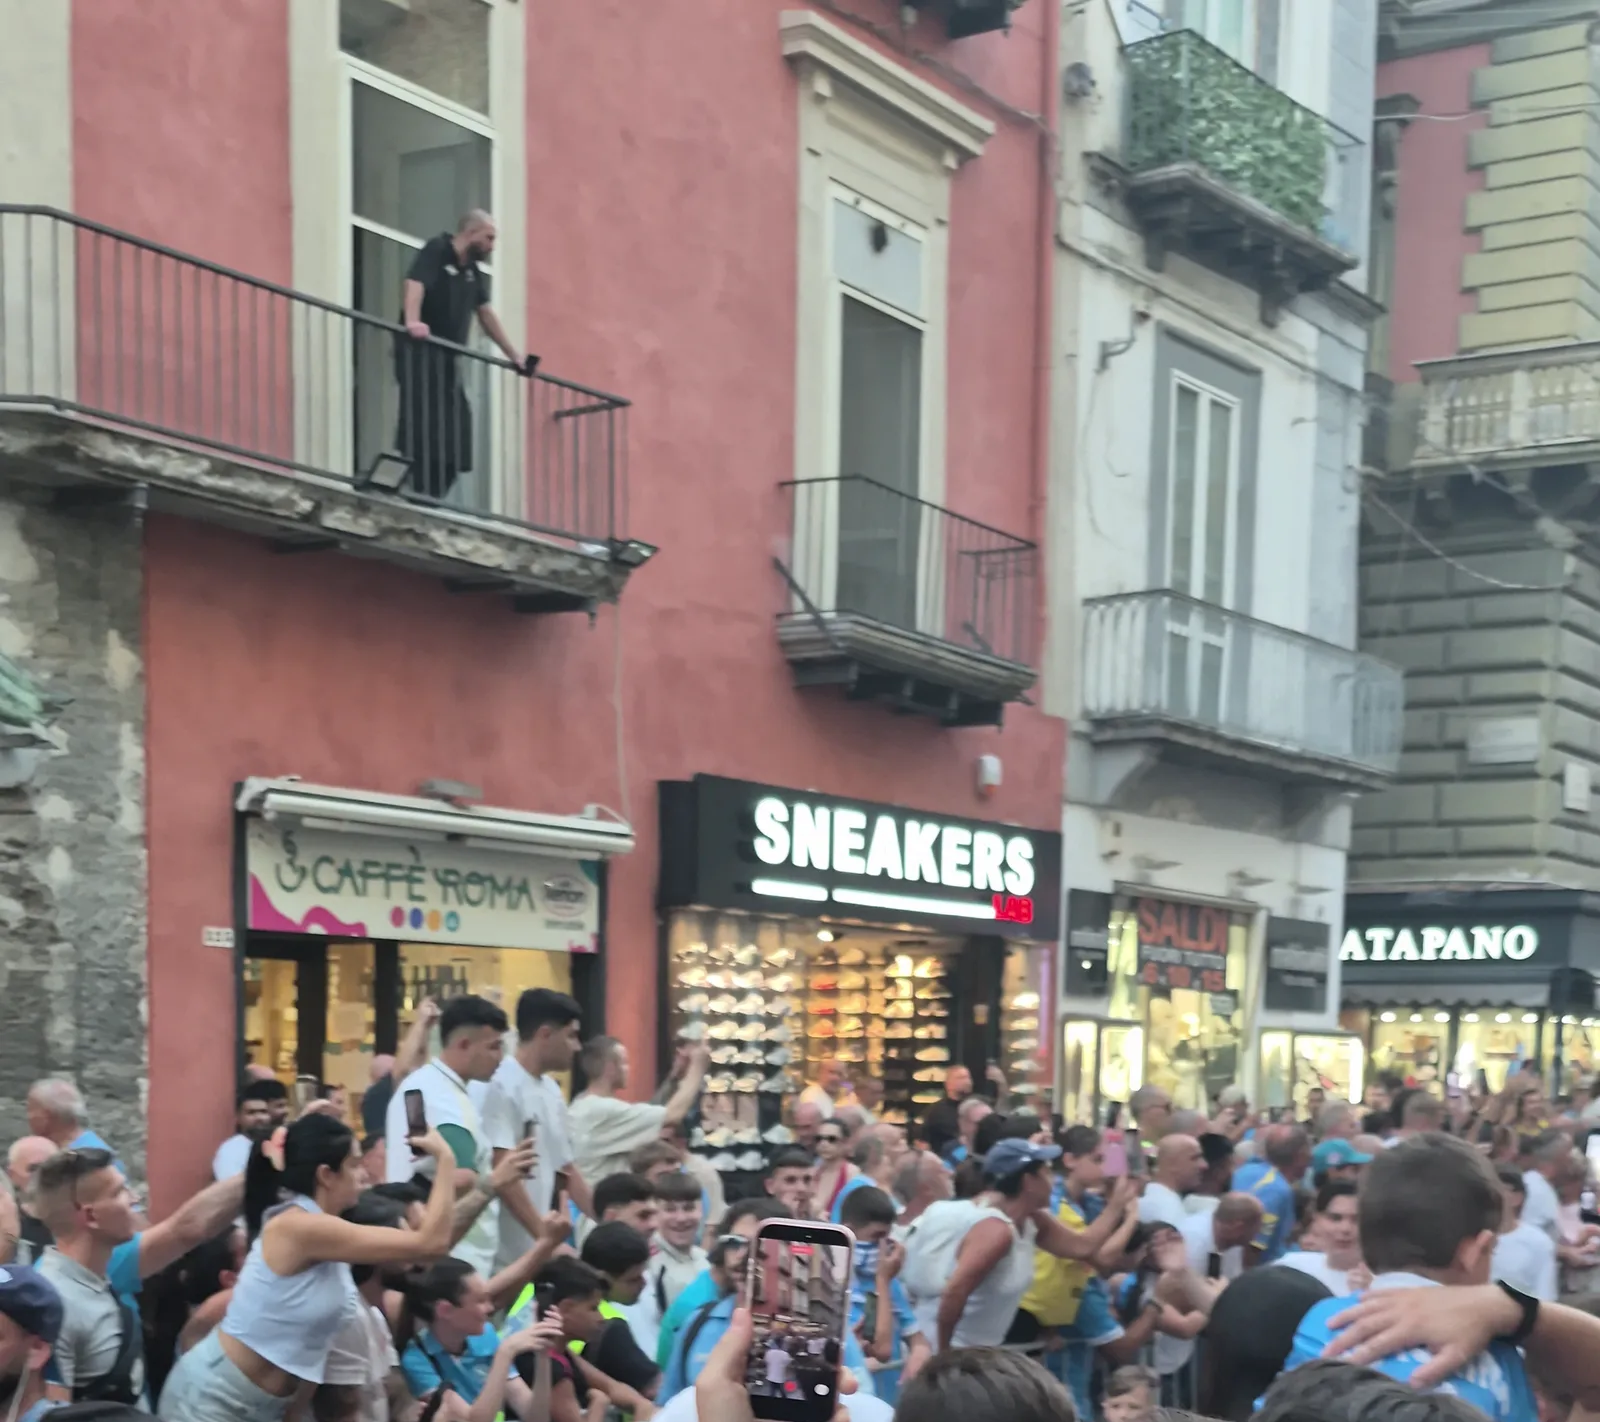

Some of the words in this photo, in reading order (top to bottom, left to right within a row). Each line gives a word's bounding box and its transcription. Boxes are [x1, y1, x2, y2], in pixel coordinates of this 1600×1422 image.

[753, 797, 1035, 896] SNEAKERS
[311, 845, 428, 903] CAFFÈ
[434, 867, 537, 912] ROMA
[992, 893, 1034, 924] LAB
[1137, 898, 1228, 954] SALDI
[1337, 924, 1539, 961] ATAPANO
